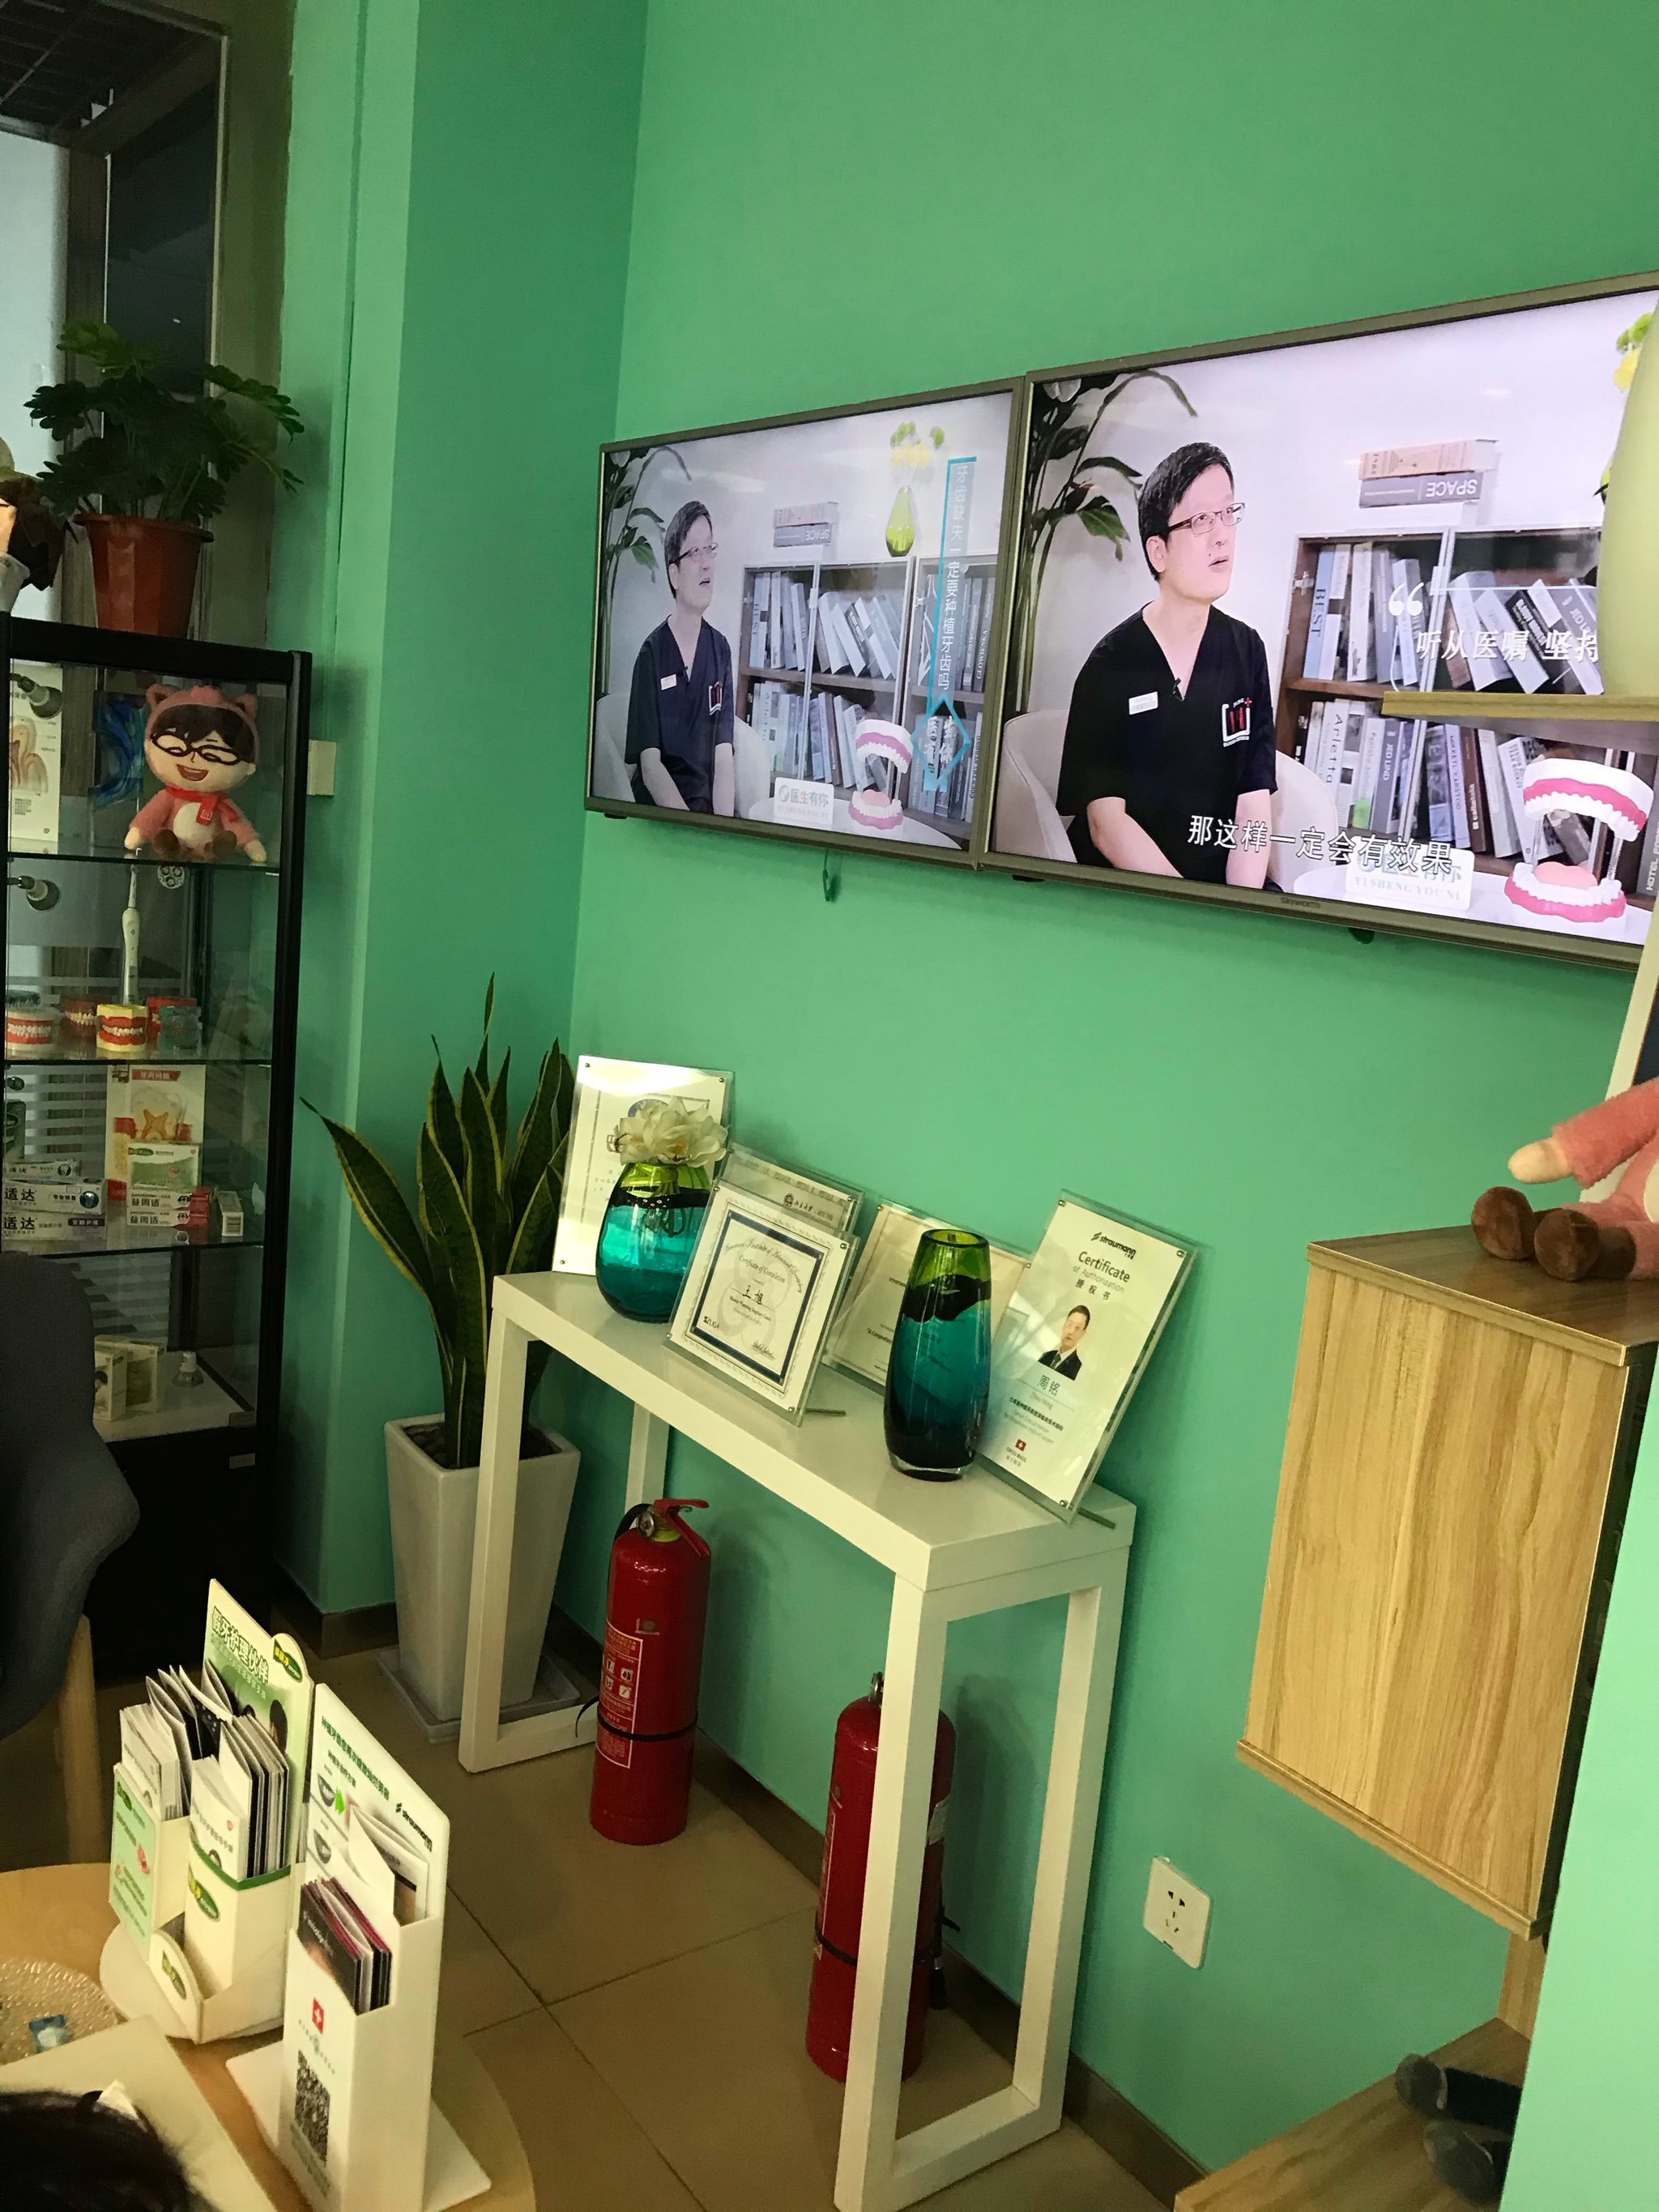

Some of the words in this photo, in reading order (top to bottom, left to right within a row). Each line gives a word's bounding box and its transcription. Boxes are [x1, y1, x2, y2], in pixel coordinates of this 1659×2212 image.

[1425, 478, 1478, 498] SPACE
[1417, 630, 1530, 662] 听从医嘱
[1188, 814, 1453, 875] 那这样一定会有效果
[1099, 1235, 1137, 1256] straumann
[1072, 1264, 1081, 1273] of
[1081, 1268, 1125, 1294] Authorization
[1077, 1250, 1131, 1283] Certificate
[1075, 1278, 1111, 1301] 授权书
[1038, 1374, 1060, 1396] 周铭
[212, 1605, 270, 1685] 假牙护理伙伴
